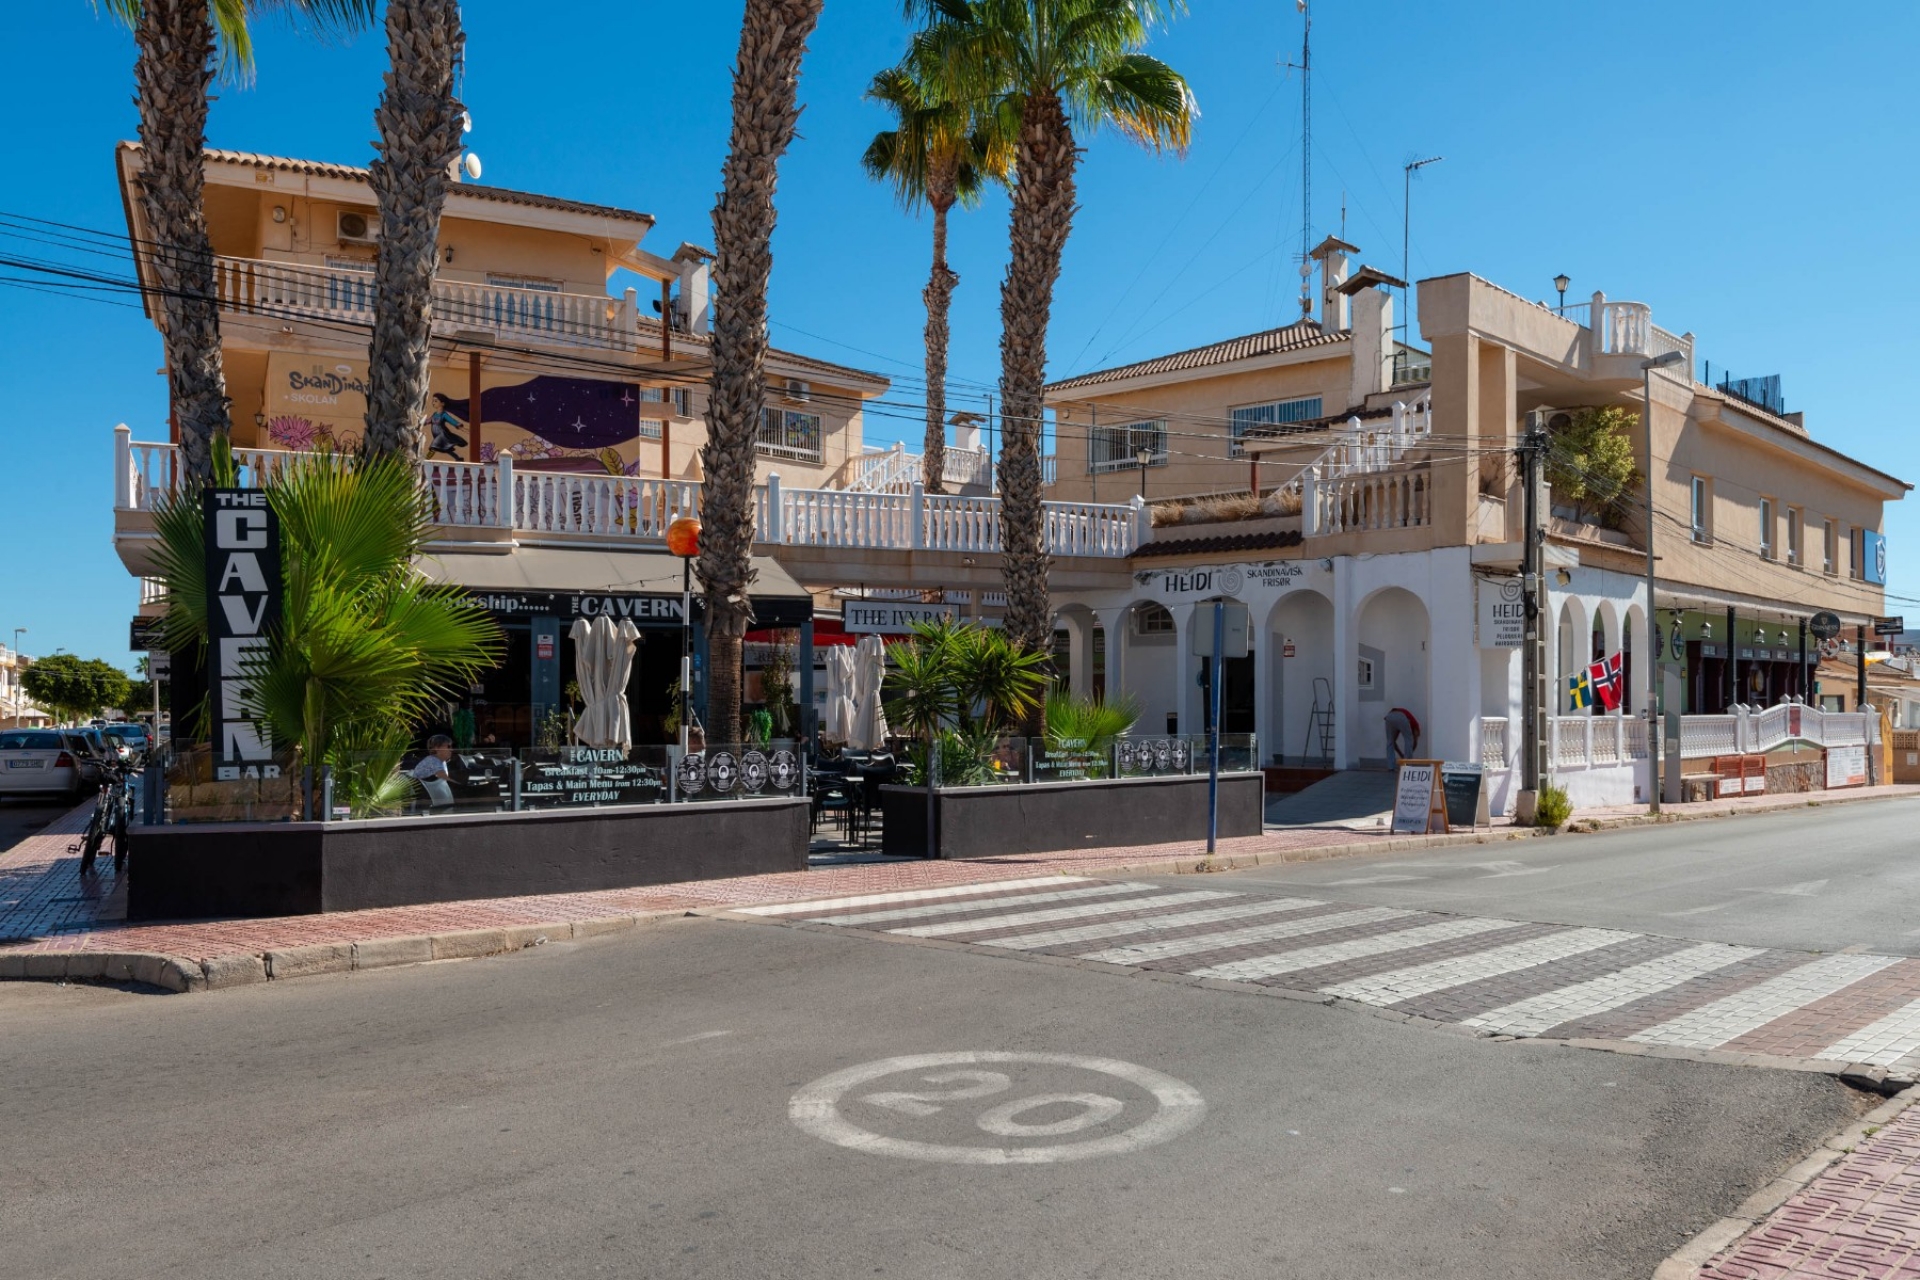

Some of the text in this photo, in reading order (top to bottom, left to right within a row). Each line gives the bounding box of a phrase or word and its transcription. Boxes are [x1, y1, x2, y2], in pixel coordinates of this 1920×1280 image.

[291, 393, 337, 405] SKOLAN
[215, 493, 267, 507] THE
[1165, 571, 1212, 592] HEIDI
[571, 596, 685, 617] THE CAVERN
[1493, 604, 1524, 618] HEID
[851, 608, 887, 626] THE
[893, 609, 918, 627] IVY
[216, 509, 273, 762] CAVERN
[577, 749, 624, 763] CAVERN
[217, 765, 281, 781] BAR
[545, 767, 588, 776] Breakfast
[1403, 770, 1432, 782] HEIDI
[526, 781, 553, 792] Tapas
[556, 781, 563, 790] &
[566, 780, 587, 789] Main
[589, 779, 613, 789] Menu
[573, 790, 620, 802] EVERYDAY
[862, 1069, 1124, 1136] 20
